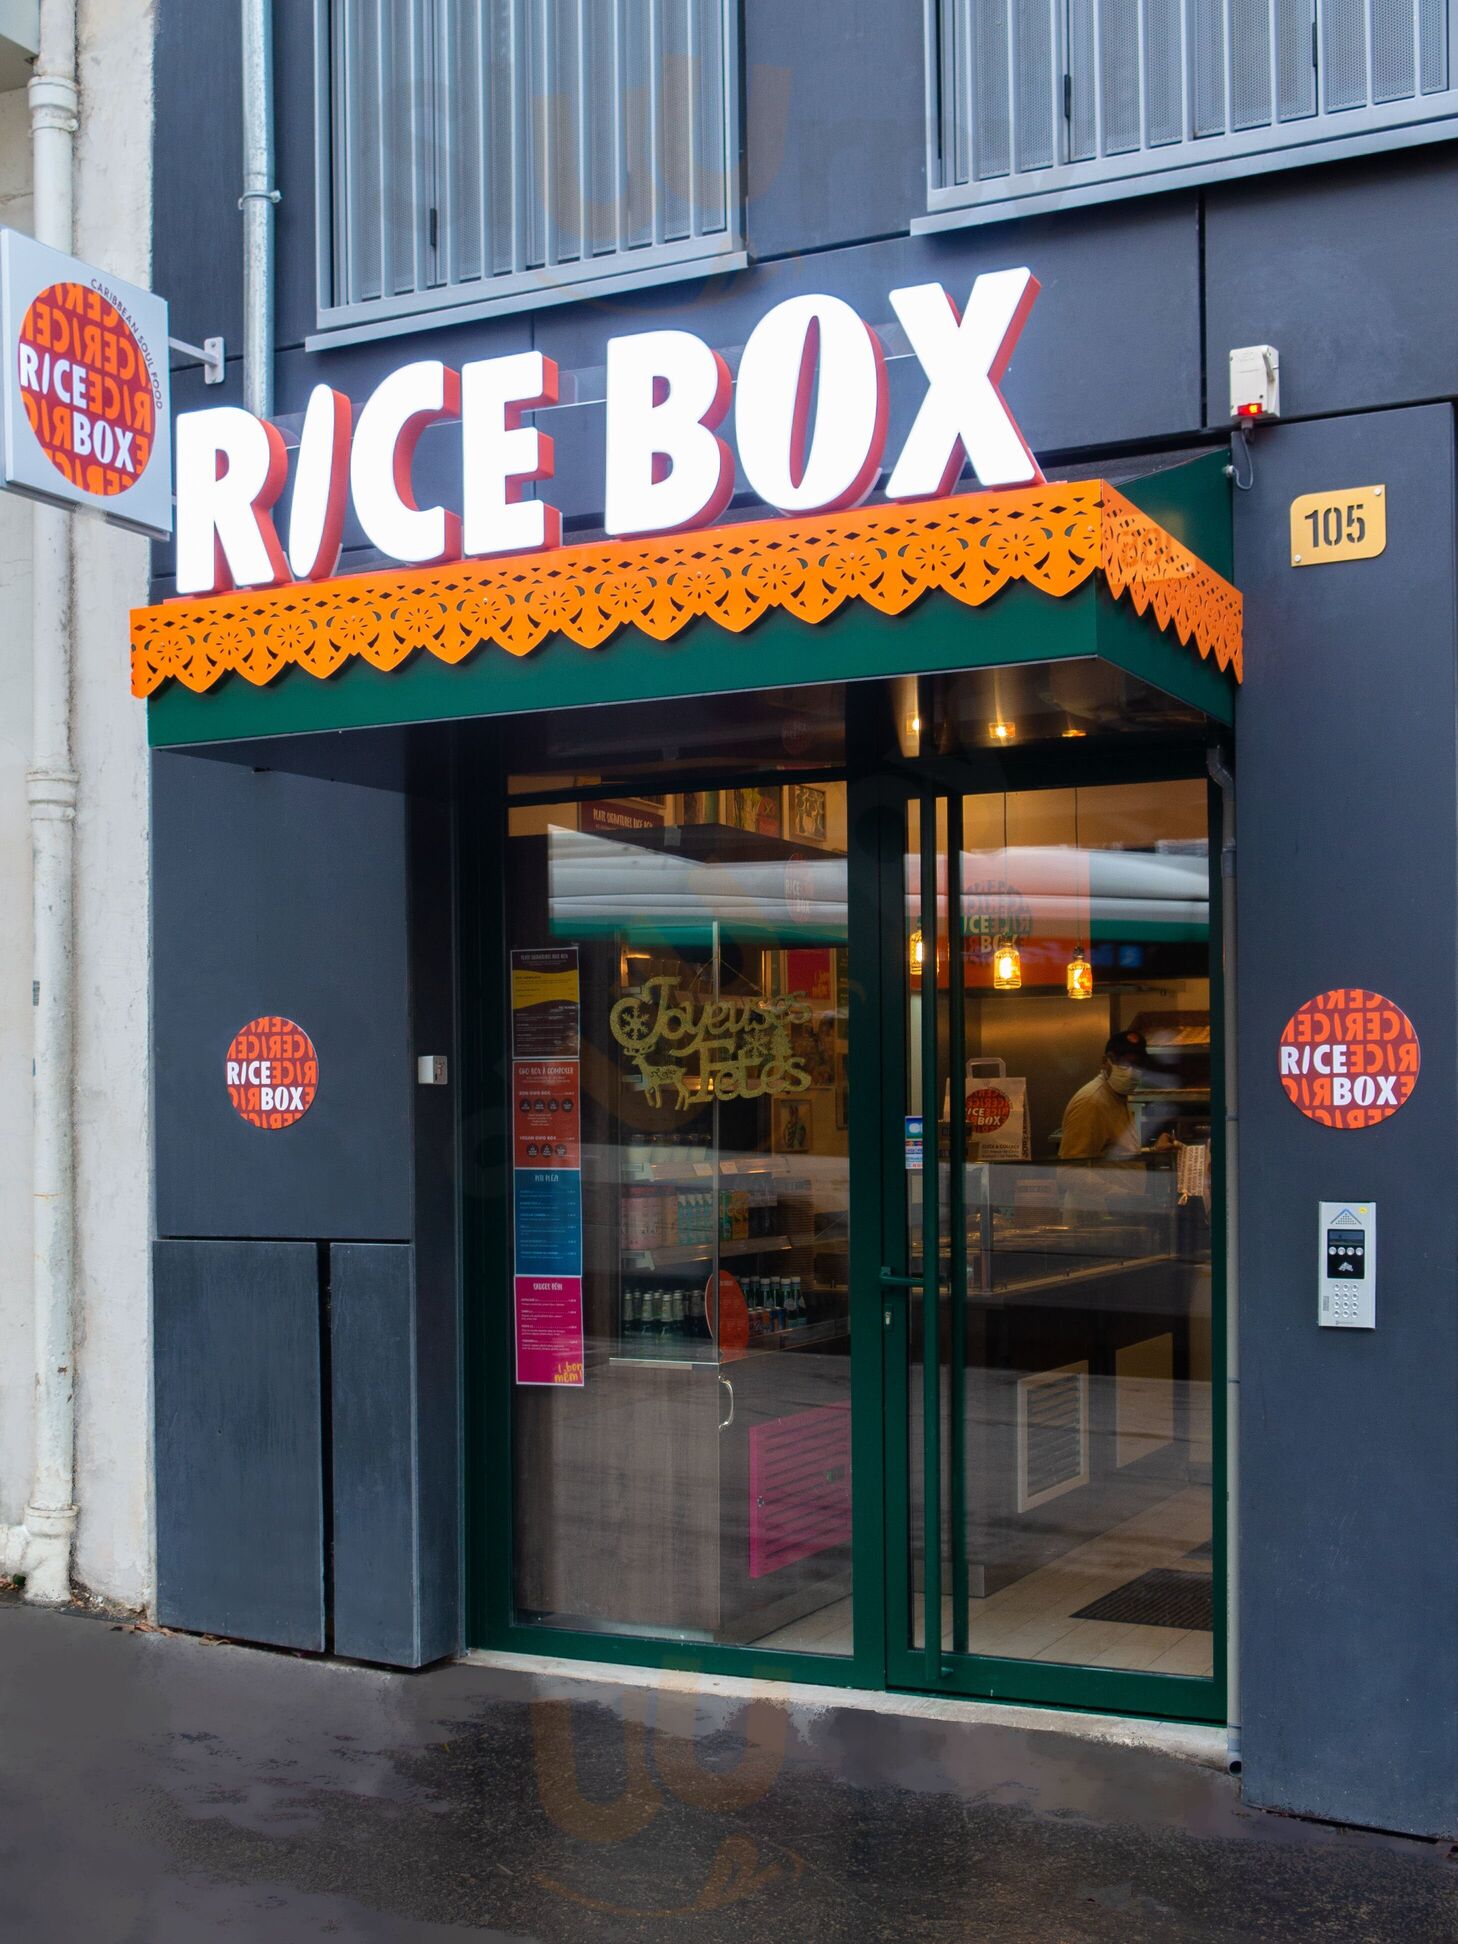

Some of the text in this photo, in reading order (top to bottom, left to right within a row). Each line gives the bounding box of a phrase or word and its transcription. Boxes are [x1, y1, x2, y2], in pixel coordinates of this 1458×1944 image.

[90, 278, 164, 410] CARIBBEAN SOUL FOOD
[19, 342, 87, 409] RICE
[73, 412, 135, 473] BOX
[177, 266, 1042, 595] RICE BOX
[1304, 504, 1366, 548] 105
[964, 914, 990, 934] ICE
[227, 1060, 271, 1085] RICE
[1280, 1044, 1348, 1075] RICE
[261, 1086, 304, 1110] BOX
[1333, 1076, 1398, 1106] BOX
[968, 1108, 985, 1116] ICE
[977, 1116, 1000, 1126] BOX
